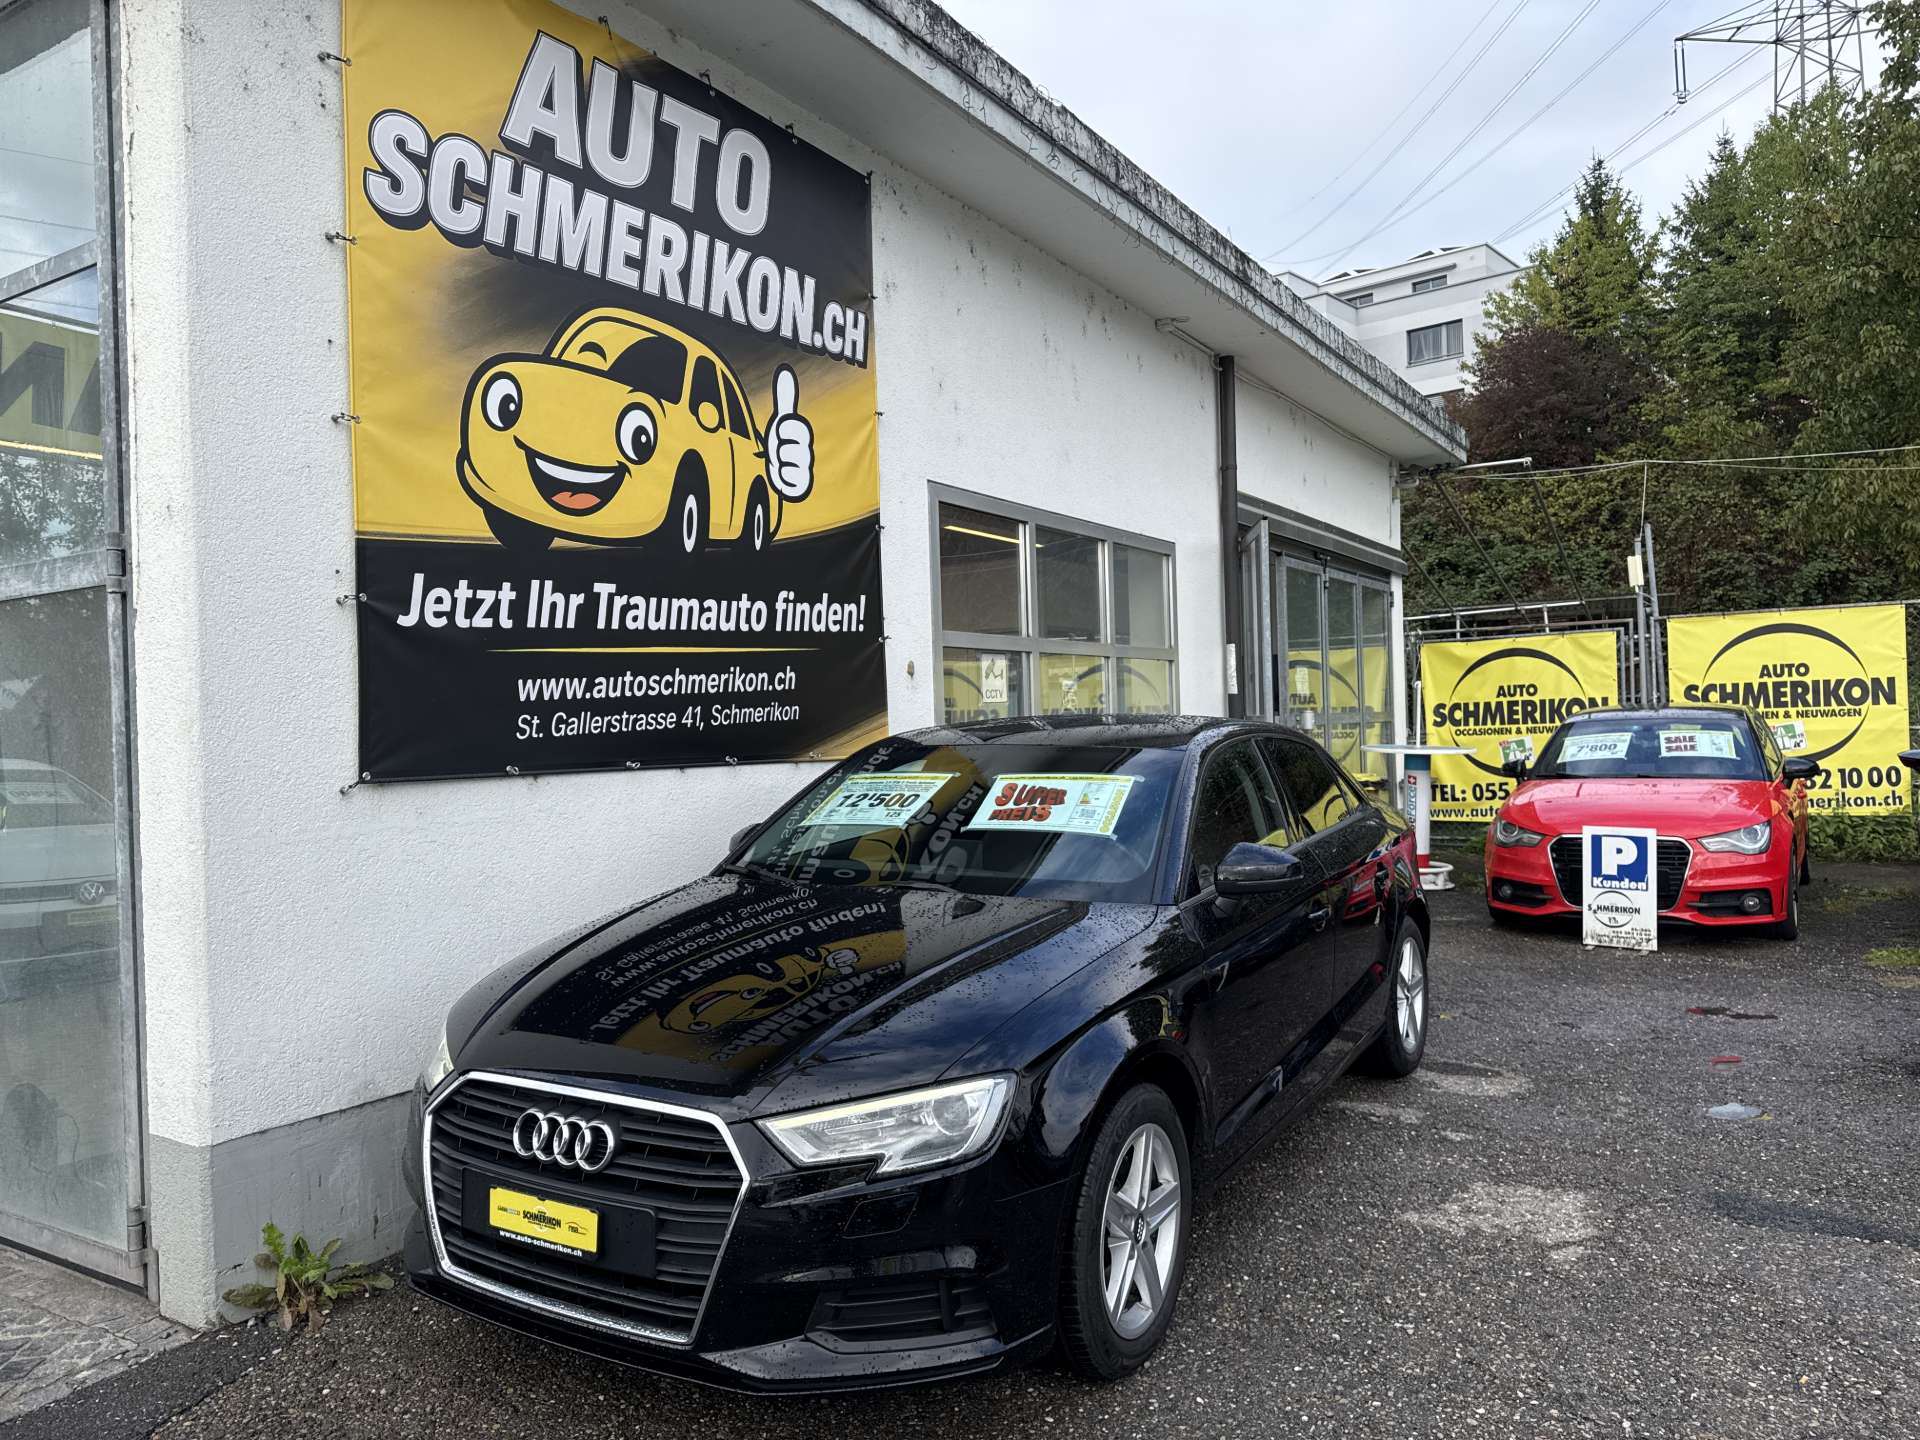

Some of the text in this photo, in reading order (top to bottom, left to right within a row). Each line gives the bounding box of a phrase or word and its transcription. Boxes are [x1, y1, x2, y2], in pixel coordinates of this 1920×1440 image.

[502, 31, 772, 236] AUTO
[365, 110, 868, 362] SCHMERIKON.CH
[397, 573, 865, 632] Jetzt Ihr Traumauto finden!
[1759, 663, 1810, 679] AUTO
[517, 666, 796, 702] www.autoschmerikon.ch
[985, 688, 1004, 699] CCTV
[1496, 684, 1538, 698] AUTO
[1684, 677, 1897, 709] SCHMERIKON
[516, 702, 800, 740] St. Gallerstrasse 41, Schmerikon
[1783, 710, 1791, 719] &
[1797, 708, 1862, 718] NEUWAGEN
[1455, 727, 1512, 737] OCCASIONEN
[1515, 727, 1522, 735] &
[1664, 735, 1697, 744] SALE
[1665, 744, 1698, 752] SALE
[1838, 767, 1863, 788] 10
[1868, 766, 1902, 788] 00
[836, 793, 921, 808] 12'500
[1431, 782, 1510, 802] TEL: 055
[1602, 836, 1638, 875] P
[1592, 876, 1647, 890] Kunden
[1587, 903, 1640, 915] SHMERIKON
[522, 1209, 562, 1229] SCHMERIKON
[499, 1229, 583, 1257] www.auto-schmerikon.ch
